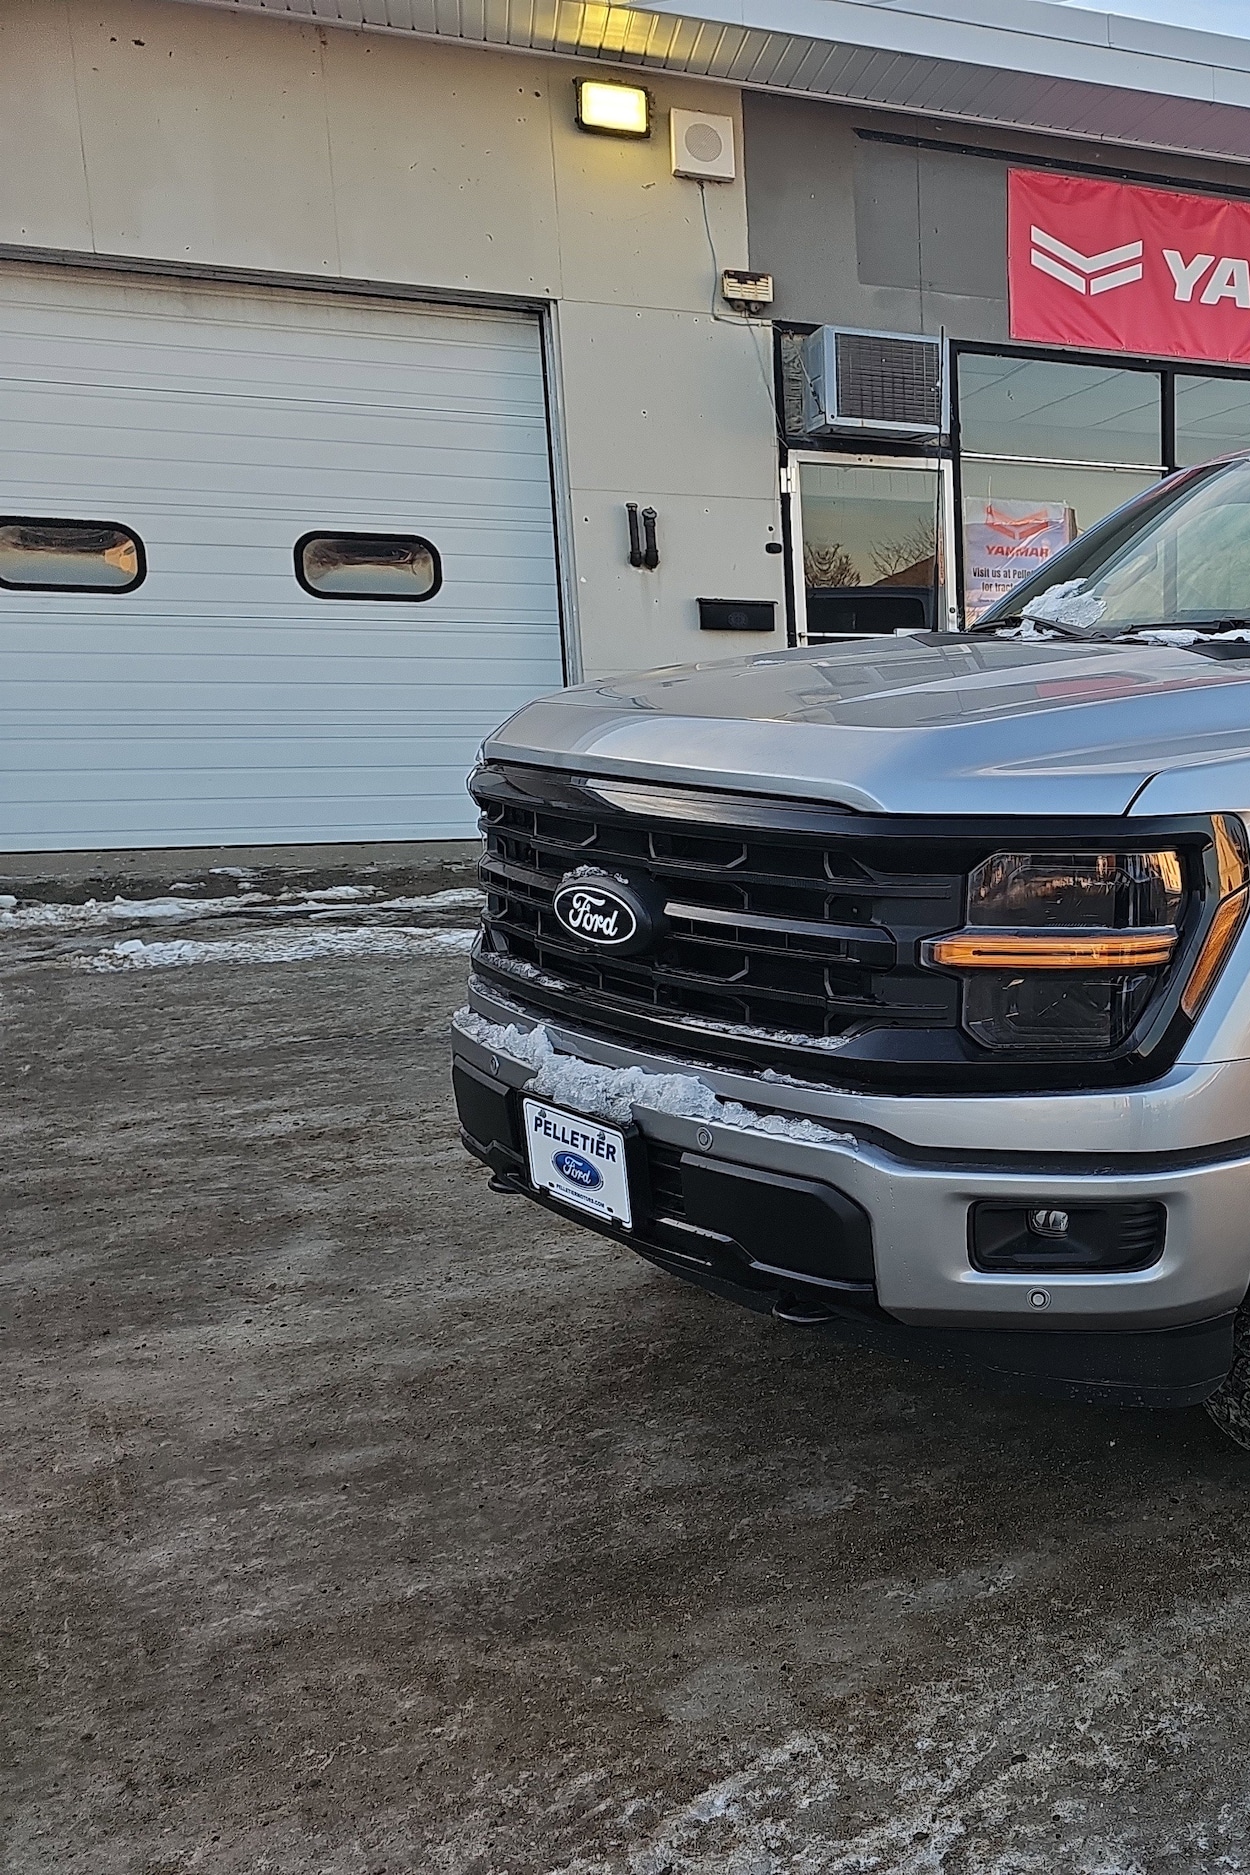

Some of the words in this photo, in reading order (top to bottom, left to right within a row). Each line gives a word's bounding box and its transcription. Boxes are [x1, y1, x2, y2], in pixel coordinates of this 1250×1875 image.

[986, 545, 1049, 558] YANMAR
[972, 567, 990, 578] Visit
[992, 569, 1001, 578] us
[1003, 568, 1011, 579] at
[982, 581, 993, 592] for
[568, 892, 618, 937] Ford
[534, 1115, 617, 1163] PELLETIER
[562, 1155, 592, 1185] Ford
